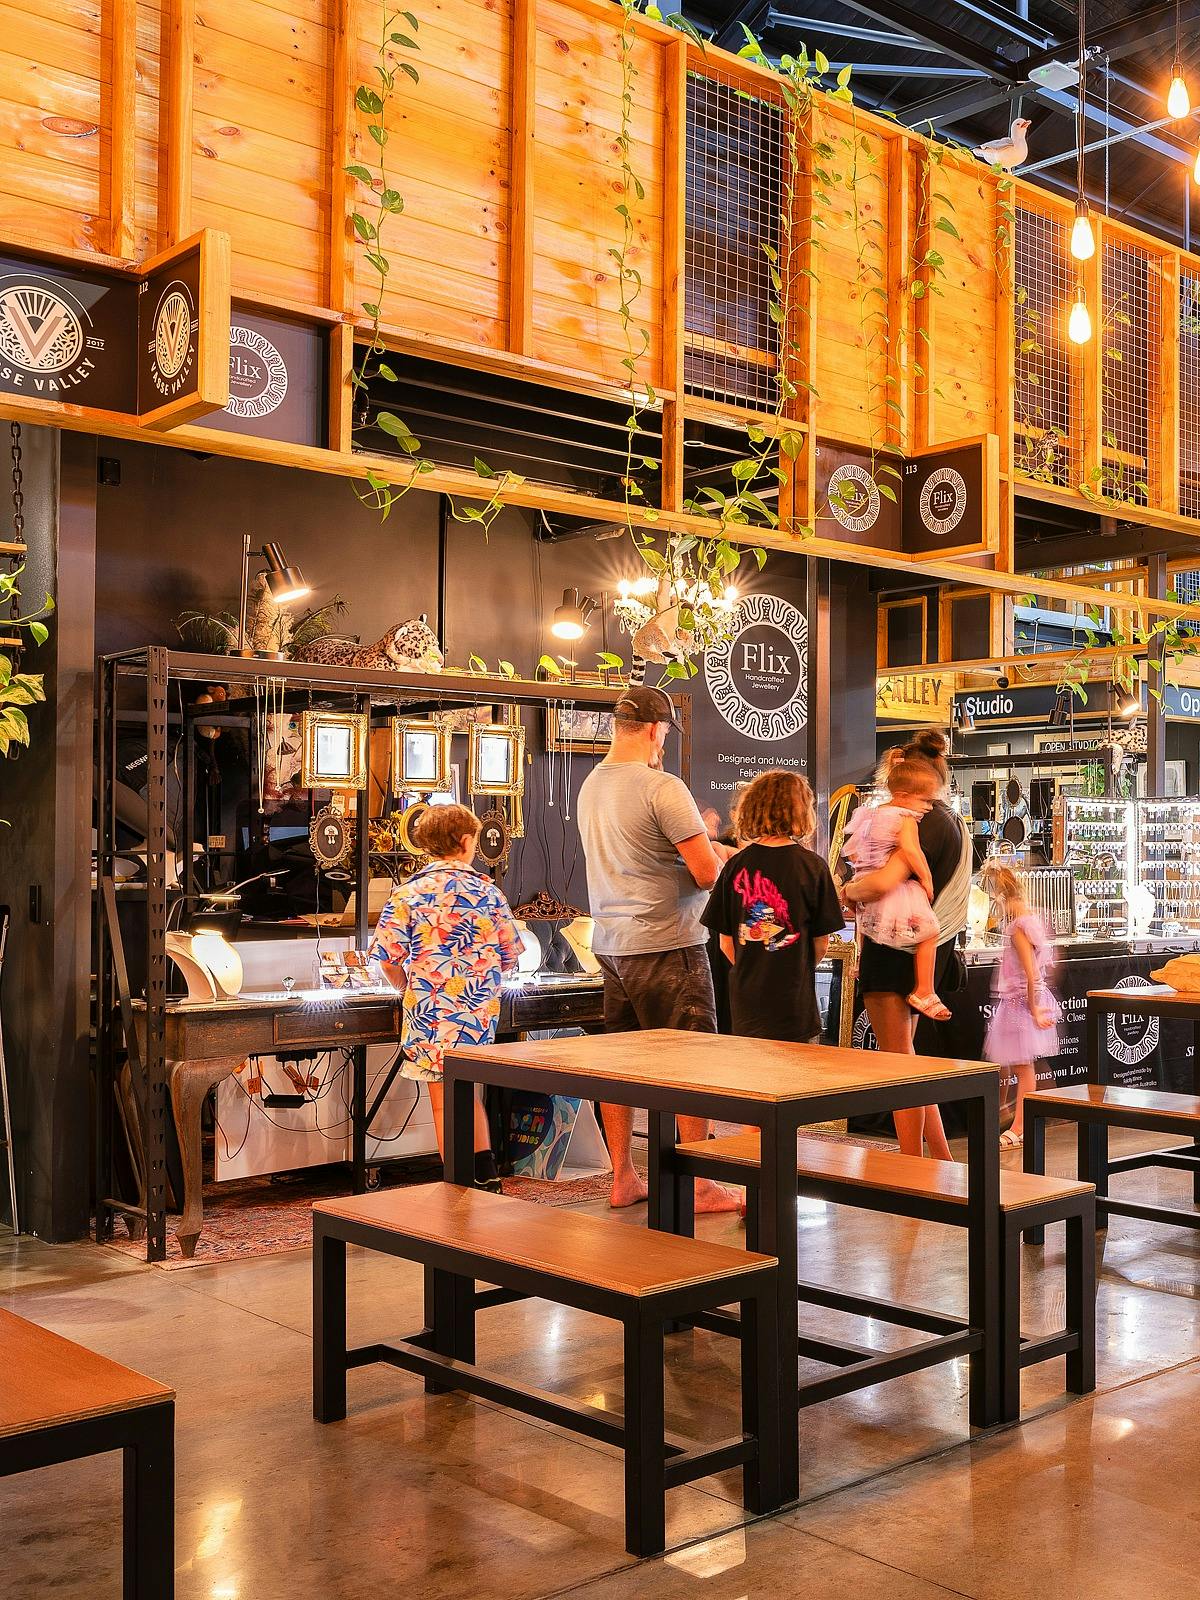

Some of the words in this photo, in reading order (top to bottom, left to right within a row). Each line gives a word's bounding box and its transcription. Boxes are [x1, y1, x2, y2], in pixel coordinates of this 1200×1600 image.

[86, 339, 105, 348] 2017
[33, 357, 96, 392] VALLEY
[150, 361, 170, 396] VASSE
[171, 344, 195, 395] VALLEY
[905, 464, 918, 475] 113
[932, 489, 954, 506] Flix
[740, 642, 792, 675] Flix
[745, 673, 785, 684] Handcrafted
[751, 683, 781, 692] Jewellery
[891, 675, 943, 706] ALLEY
[965, 695, 1014, 717] Studio
[1044, 742, 1066, 752] OPEN
[717, 753, 756, 766] Designed
[757, 755, 774, 765] and
[775, 757, 799, 767] Made
[1066, 1012, 1086, 1023] Close
[1035, 1072, 1052, 1081] ones
[1052, 1068, 1067, 1081] you
[1070, 1064, 1088, 1075] Lov
